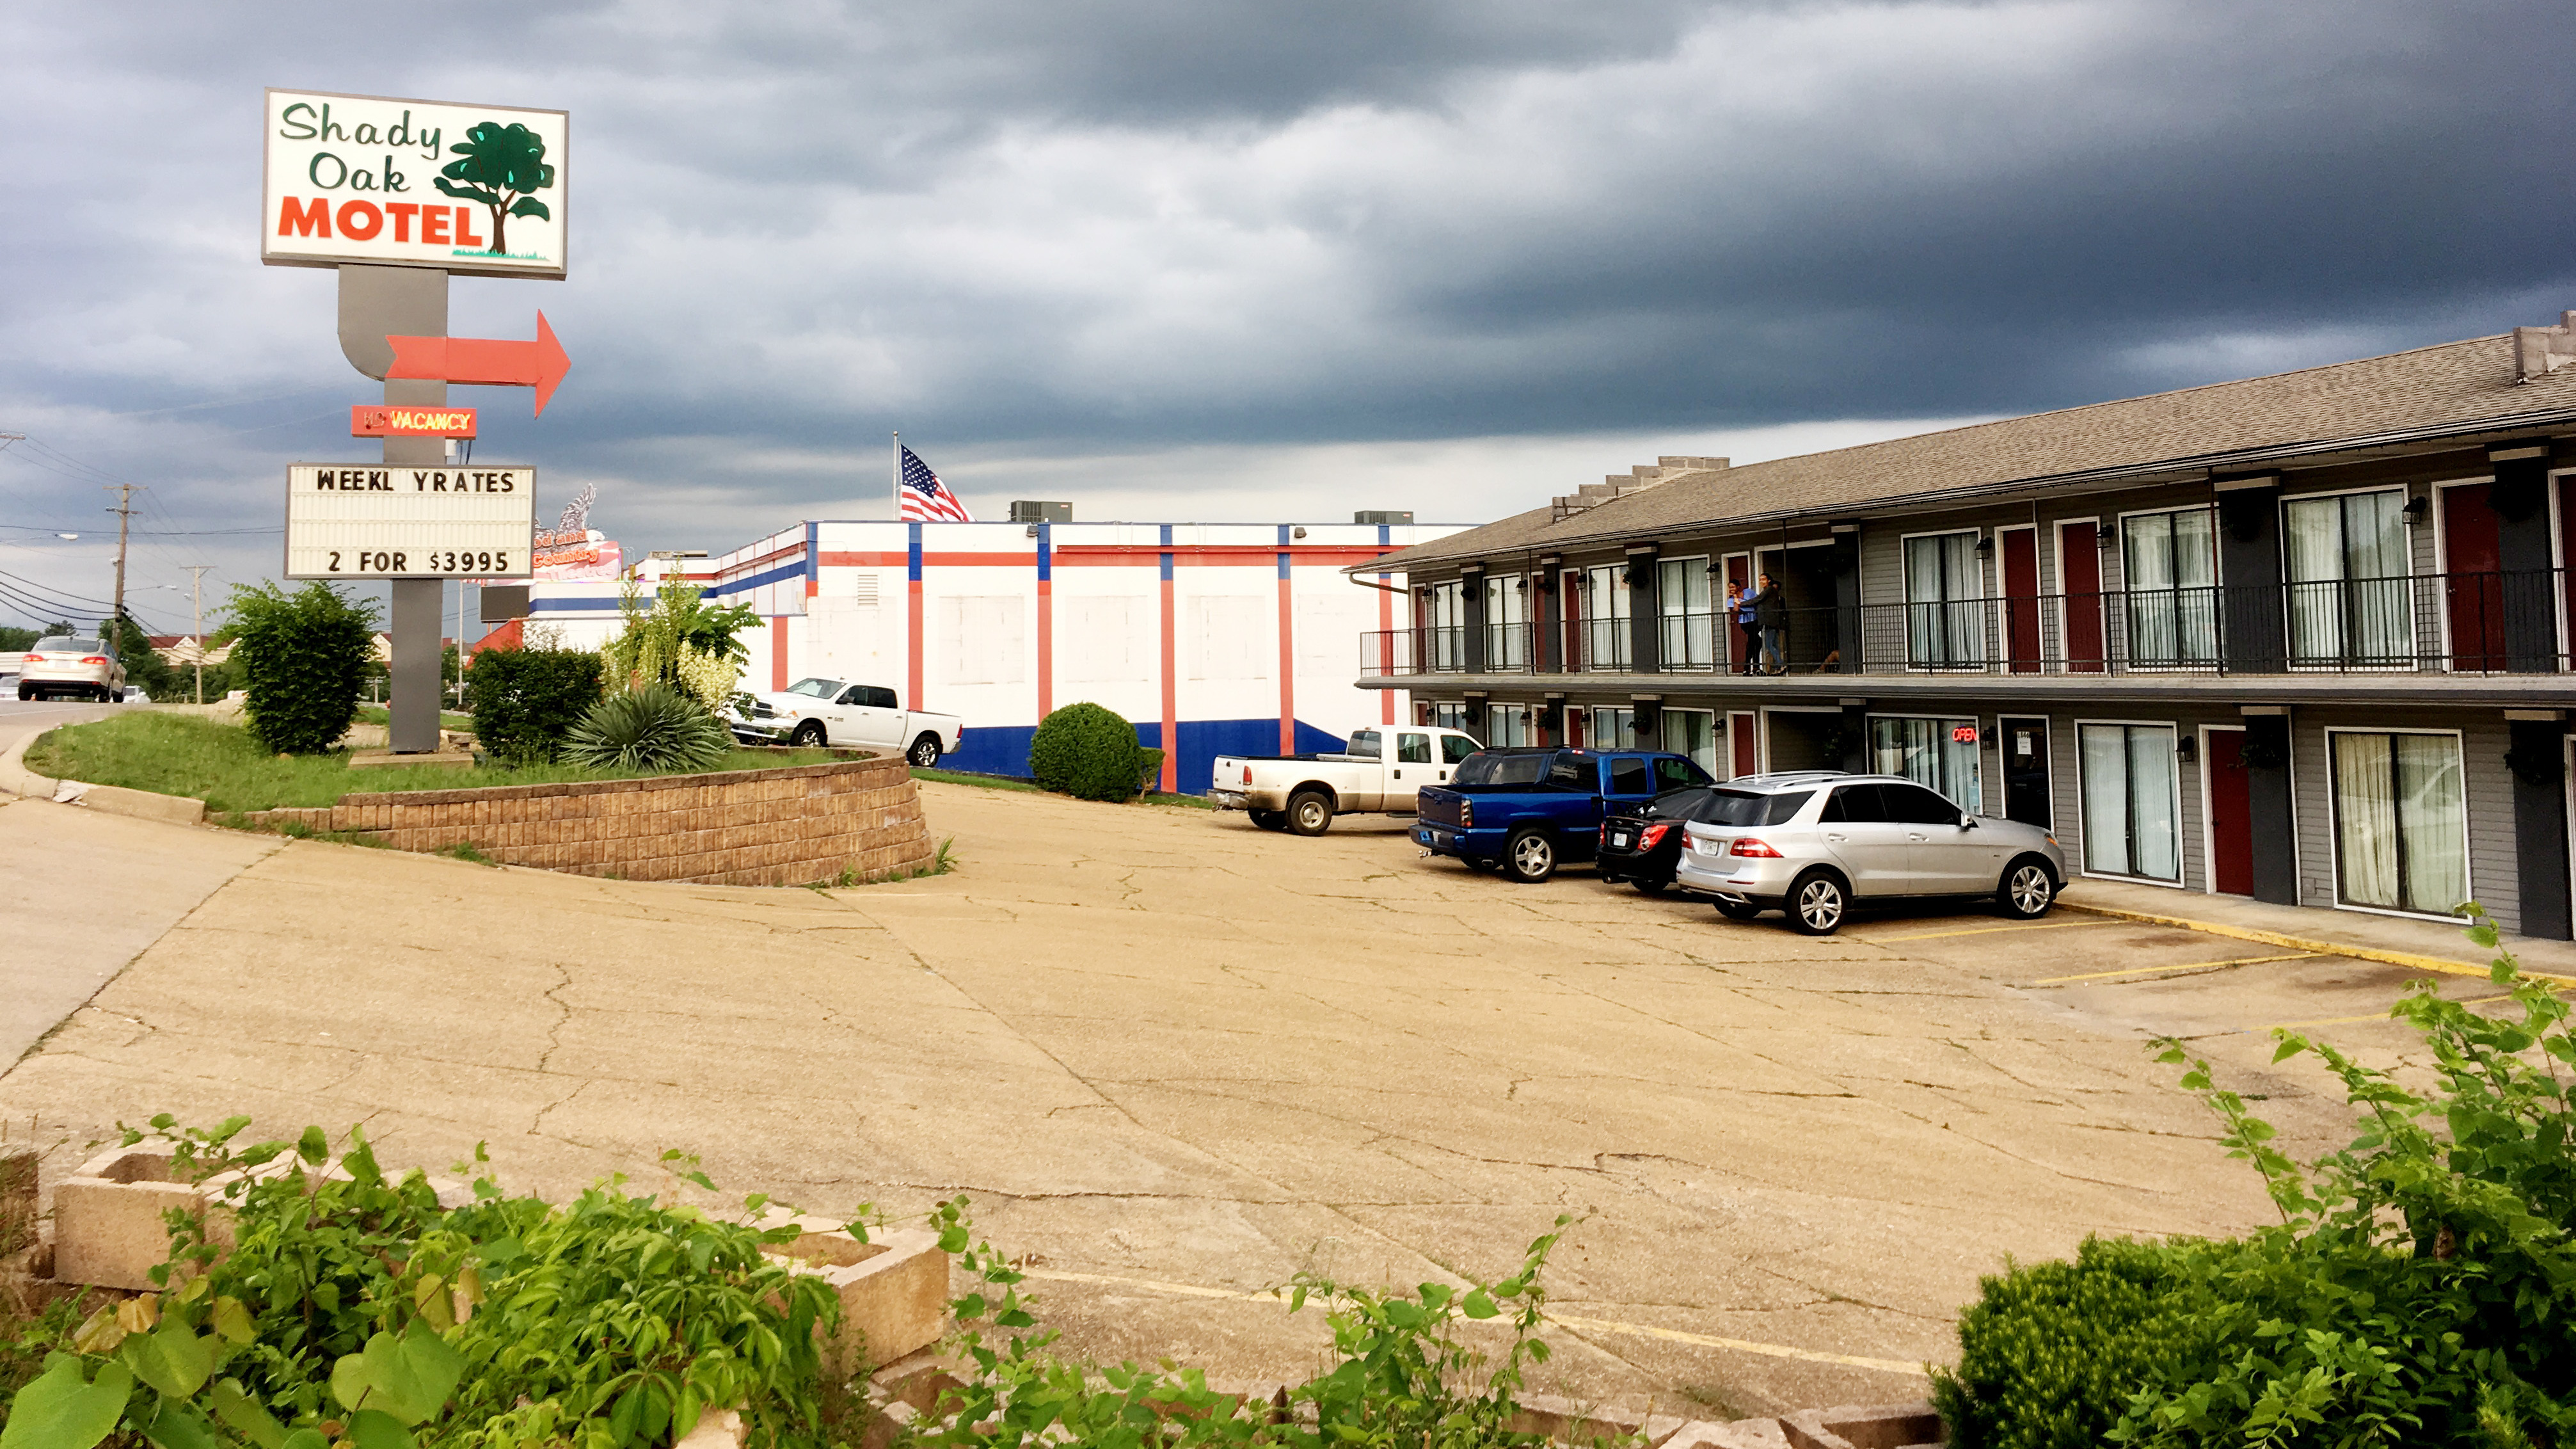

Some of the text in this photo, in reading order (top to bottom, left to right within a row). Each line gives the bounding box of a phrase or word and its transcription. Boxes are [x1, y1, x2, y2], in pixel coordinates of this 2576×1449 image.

[280, 102, 441, 160] Shady
[309, 152, 411, 192] Oak
[278, 196, 482, 246] MOTEL
[389, 411, 471, 430] VACANCY
[317, 470, 513, 493] WEEKL YRATES
[534, 529, 587, 548] od and
[329, 552, 507, 572] 2 FOR $3995
[533, 548, 600, 568] Country
[547, 564, 614, 580] Theatres
[1952, 727, 1978, 742] OPEN
